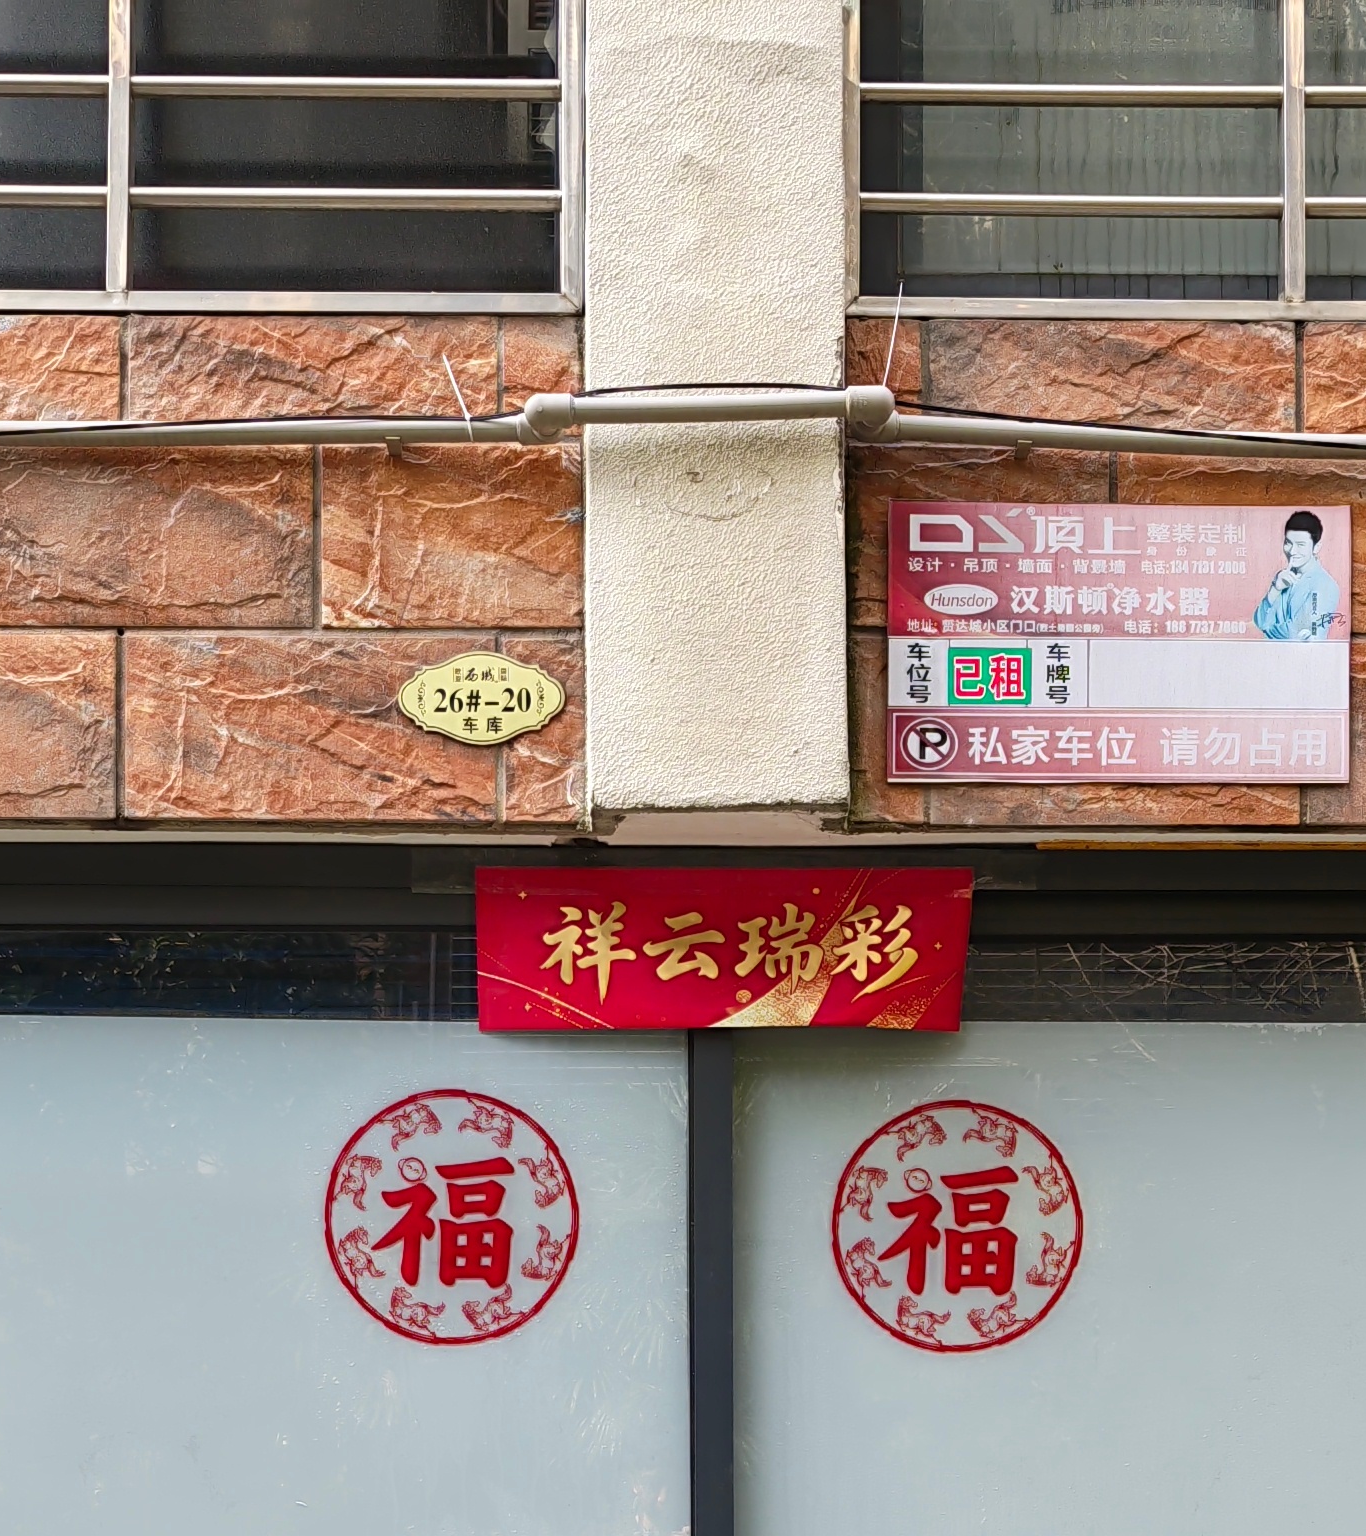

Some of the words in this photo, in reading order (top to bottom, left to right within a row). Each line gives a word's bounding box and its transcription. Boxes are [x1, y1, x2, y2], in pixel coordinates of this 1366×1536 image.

[1031, 514, 1142, 554] 顶上
[1146, 523, 1246, 545] 整装定制
[930, 593, 994, 608] Hunsdon
[1010, 585, 1210, 616] 汉斯顿净水器
[906, 642, 932, 704] 车位号
[953, 654, 1026, 700] 已租
[1045, 642, 1071, 705] 车牌号
[433, 688, 532, 713] 26#-20
[462, 716, 504, 734] 车库
[968, 725, 1137, 766] 私家车位
[1159, 726, 1328, 767] 请勿占用
[539, 900, 920, 1006] 祥云瑞彩
[370, 1156, 516, 1289] 福
[877, 1164, 1019, 1297] 福
